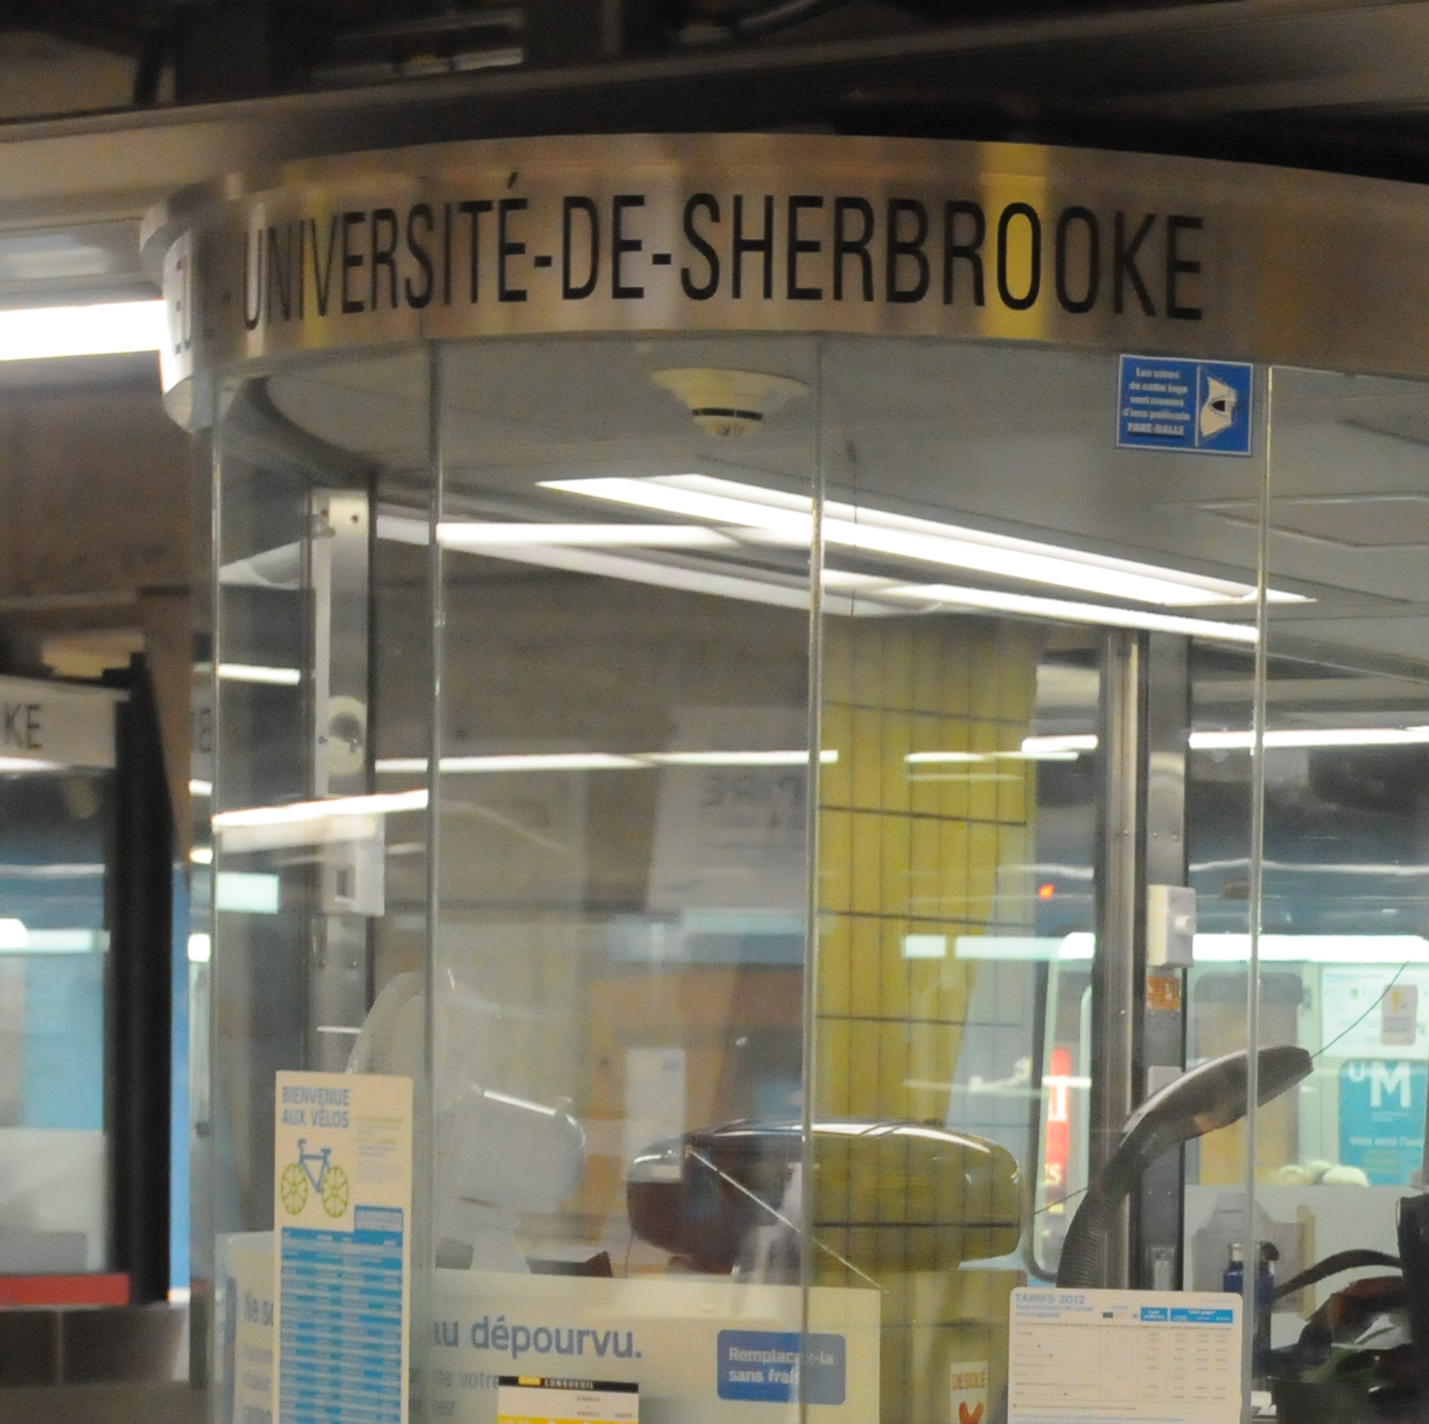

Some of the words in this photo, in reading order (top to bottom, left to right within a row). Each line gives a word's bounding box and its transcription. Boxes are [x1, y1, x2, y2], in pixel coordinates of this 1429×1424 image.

[243, 171, 1204, 332] UNIVERSITÉ-DE-SHERBROOKE
[1016, 1294, 1058, 1304] TARIFS
[472, 1315, 642, 1360] dépourvu.
[729, 1370, 764, 1383] sans
